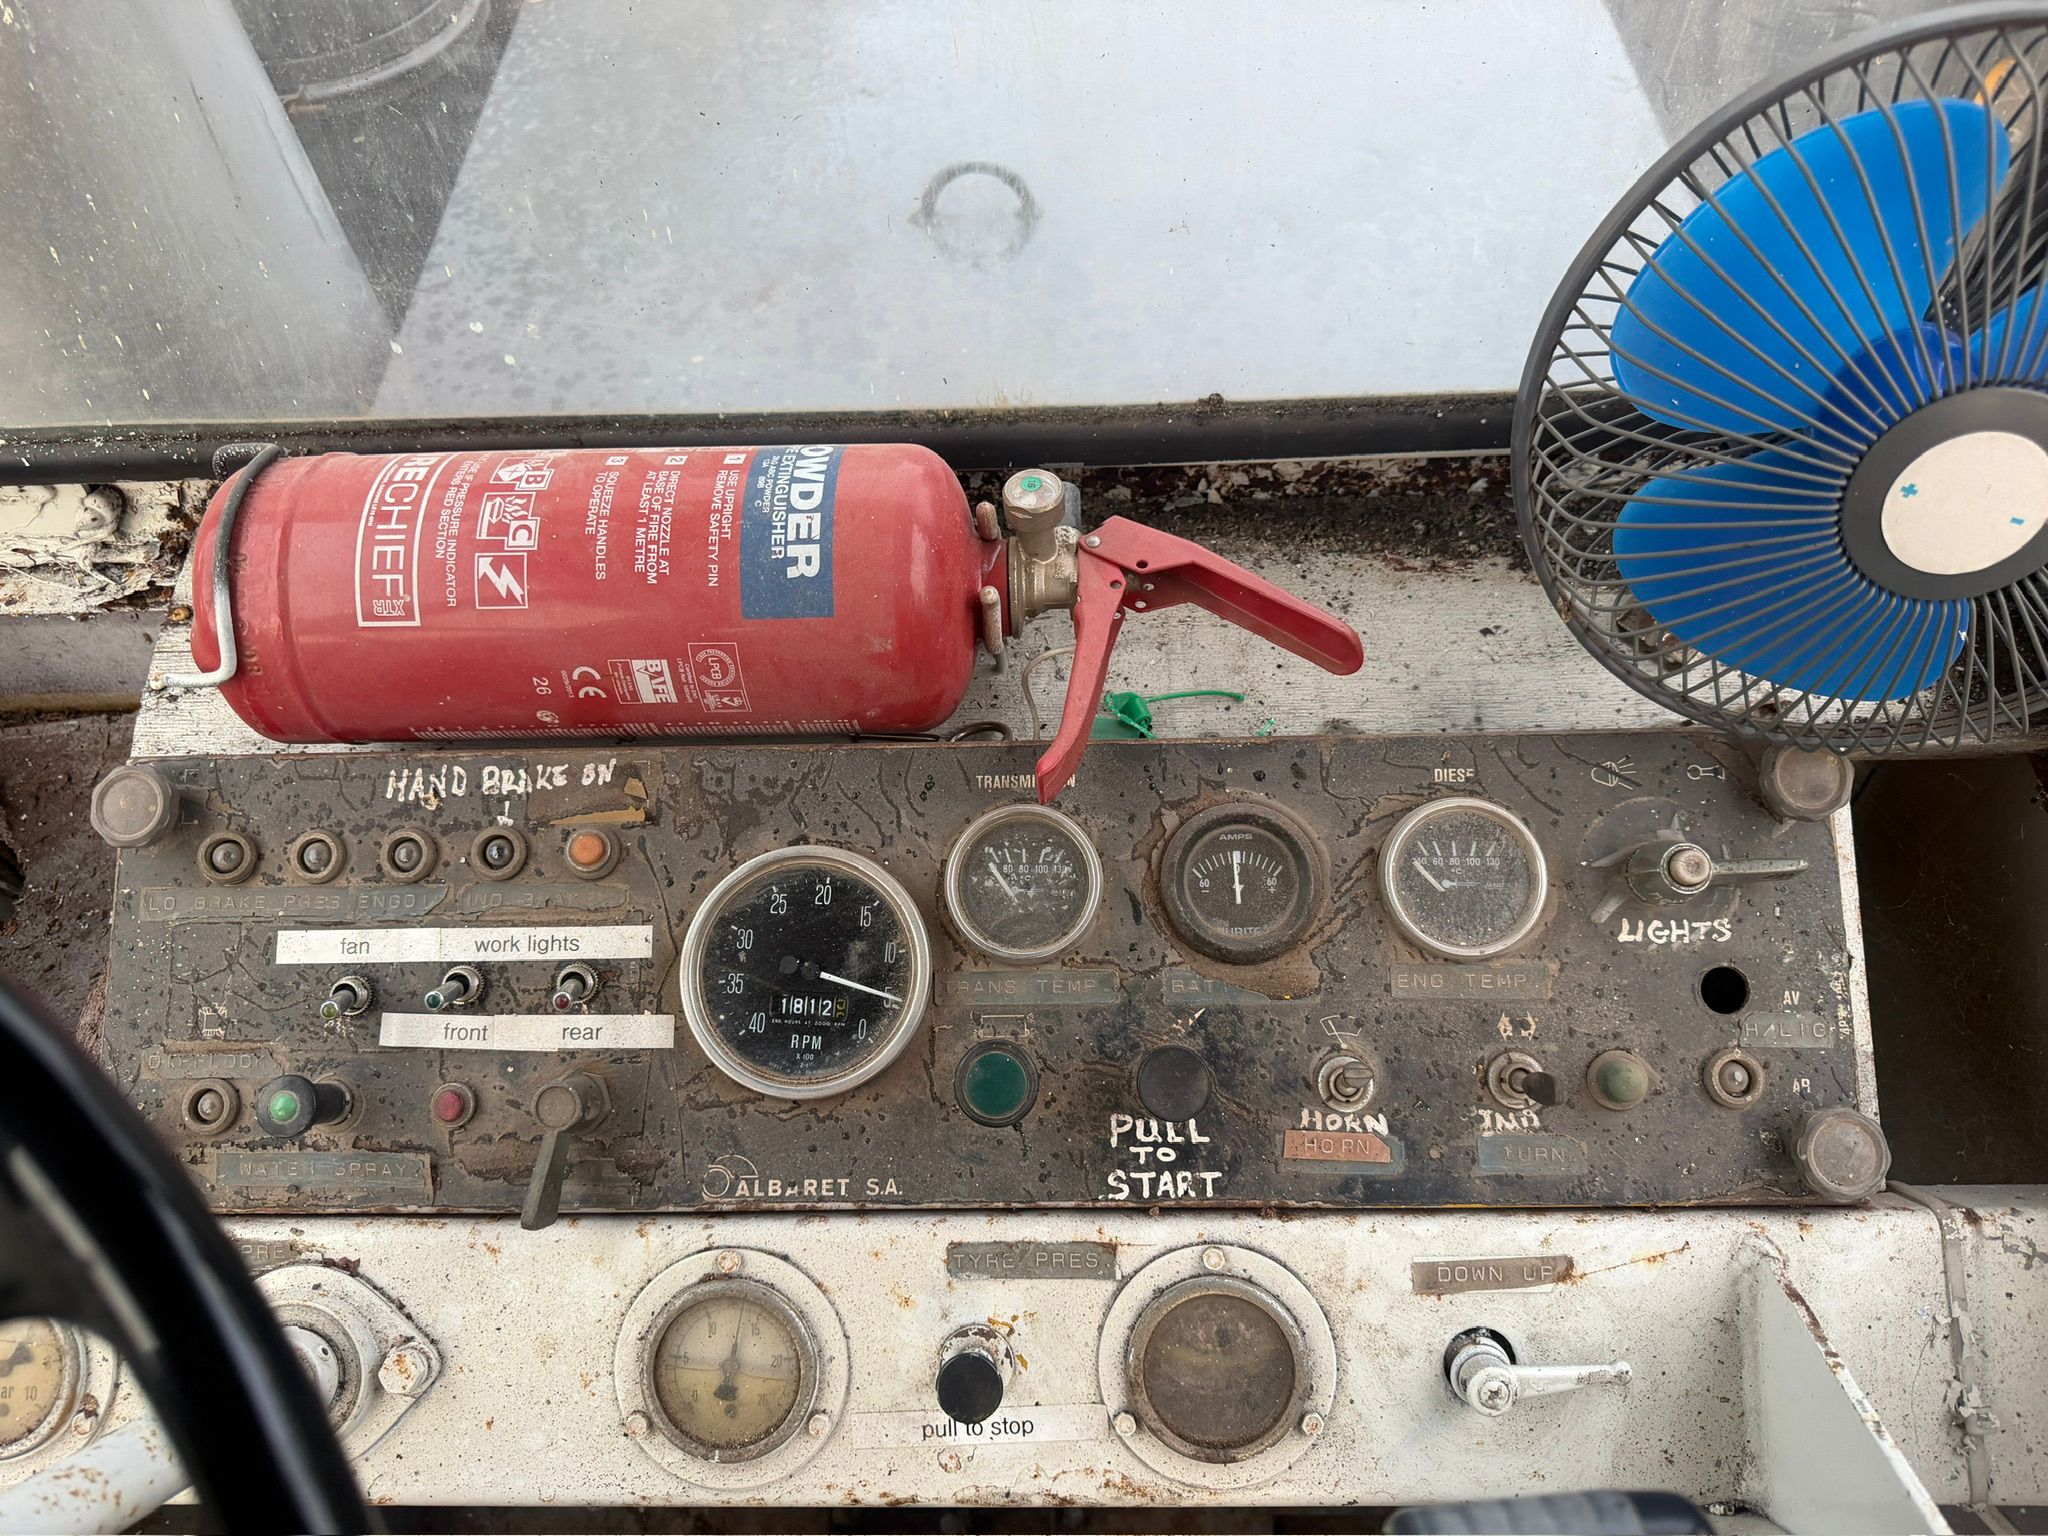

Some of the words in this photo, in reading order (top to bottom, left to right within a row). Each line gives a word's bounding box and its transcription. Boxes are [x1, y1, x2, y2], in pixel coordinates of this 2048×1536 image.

[450, 460, 473, 486] ENTERS
[595, 471, 609, 483] TO
[645, 470, 657, 481] AT
[654, 470, 669, 494] BASE
[727, 469, 740, 487] USE
[444, 486, 458, 507] RED
[600, 471, 620, 517] SQUEEZE
[664, 470, 681, 505] DIRECT
[711, 469, 728, 510] REMOVE
[762, 478, 774, 513] POWDER
[449, 482, 470, 536] PRESSURE
[638, 482, 654, 515] LEAST
[651, 496, 662, 512] OF
[771, 455, 796, 559] EXTINGUISHER
[585, 484, 603, 535] OPERATE
[720, 488, 737, 540] UPRIGHT
[435, 508, 451, 559] SECTION
[647, 514, 660, 541] FIRE
[659, 507, 673, 556] NOZZLE
[708, 513, 721, 561] SAFETY
[595, 519, 609, 580] HANDLES
[635, 527, 647, 573] METRE
[446, 539, 457, 607] INDICATOR
[647, 544, 658, 584] FROM
[659, 559, 670, 575] AT
[708, 564, 719, 587] PIN
[373, 600, 405, 616] XTR
[708, 657, 722, 681] LPCB
[532, 677, 552, 695] 26
[386, 764, 467, 802] HAND
[482, 763, 570, 795] BRAKE
[976, 774, 1076, 789] TRANSMIN
[1219, 833, 1253, 841] AMPS
[1035, 864, 1048, 874] 100
[1432, 857, 1443, 866] 60
[1449, 857, 1460, 866] 80
[1466, 857, 1480, 866] 100
[1486, 857, 1500, 866] 130
[1199, 879, 1210, 888] 60
[1266, 877, 1277, 886] 60
[770, 893, 787, 914] 25
[814, 885, 832, 905] 20
[860, 906, 872, 927] 15
[736, 929, 754, 950] 30
[1617, 918, 1733, 945] LIGHTS
[340, 937, 370, 955] fan
[474, 936, 521, 953] work
[527, 934, 580, 954] lights
[884, 942, 896, 963] 10
[727, 973, 745, 994] 35
[1036, 979, 1097, 994] TEMP
[1397, 972, 1444, 989] ENG
[1467, 972, 1528, 989] TEMP
[1783, 990, 1800, 1006] AV
[443, 1022, 488, 1041] front
[562, 1024, 603, 1041] rear
[748, 1012, 766, 1033] 40
[858, 1018, 867, 1040] 0
[790, 1034, 822, 1050] RPM
[1110, 1113, 1210, 1148] PULL
[1300, 1108, 1389, 1136] HORN
[1129, 1146, 1177, 1165] TO
[1304, 1138, 1370, 1155] HORN
[335, 1161, 413, 1176] SPRAY
[735, 1177, 850, 1198] ALBARET
[1107, 1169, 1222, 1200] START
[952, 1252, 1016, 1271] TYRE
[1035, 1251, 1100, 1269] PRES
[1437, 1265, 1504, 1283] DOWN
[1523, 1265, 1555, 1282] UP
[708, 1321, 716, 1336] 10
[751, 1322, 760, 1337] 15
[683, 1351, 690, 1365] 5
[771, 1354, 783, 1368] 20
[24, 1385, 38, 1401] 10
[922, 1417, 957, 1441] pull
[966, 1422, 984, 1437] to
[991, 1417, 1035, 1438] stop
